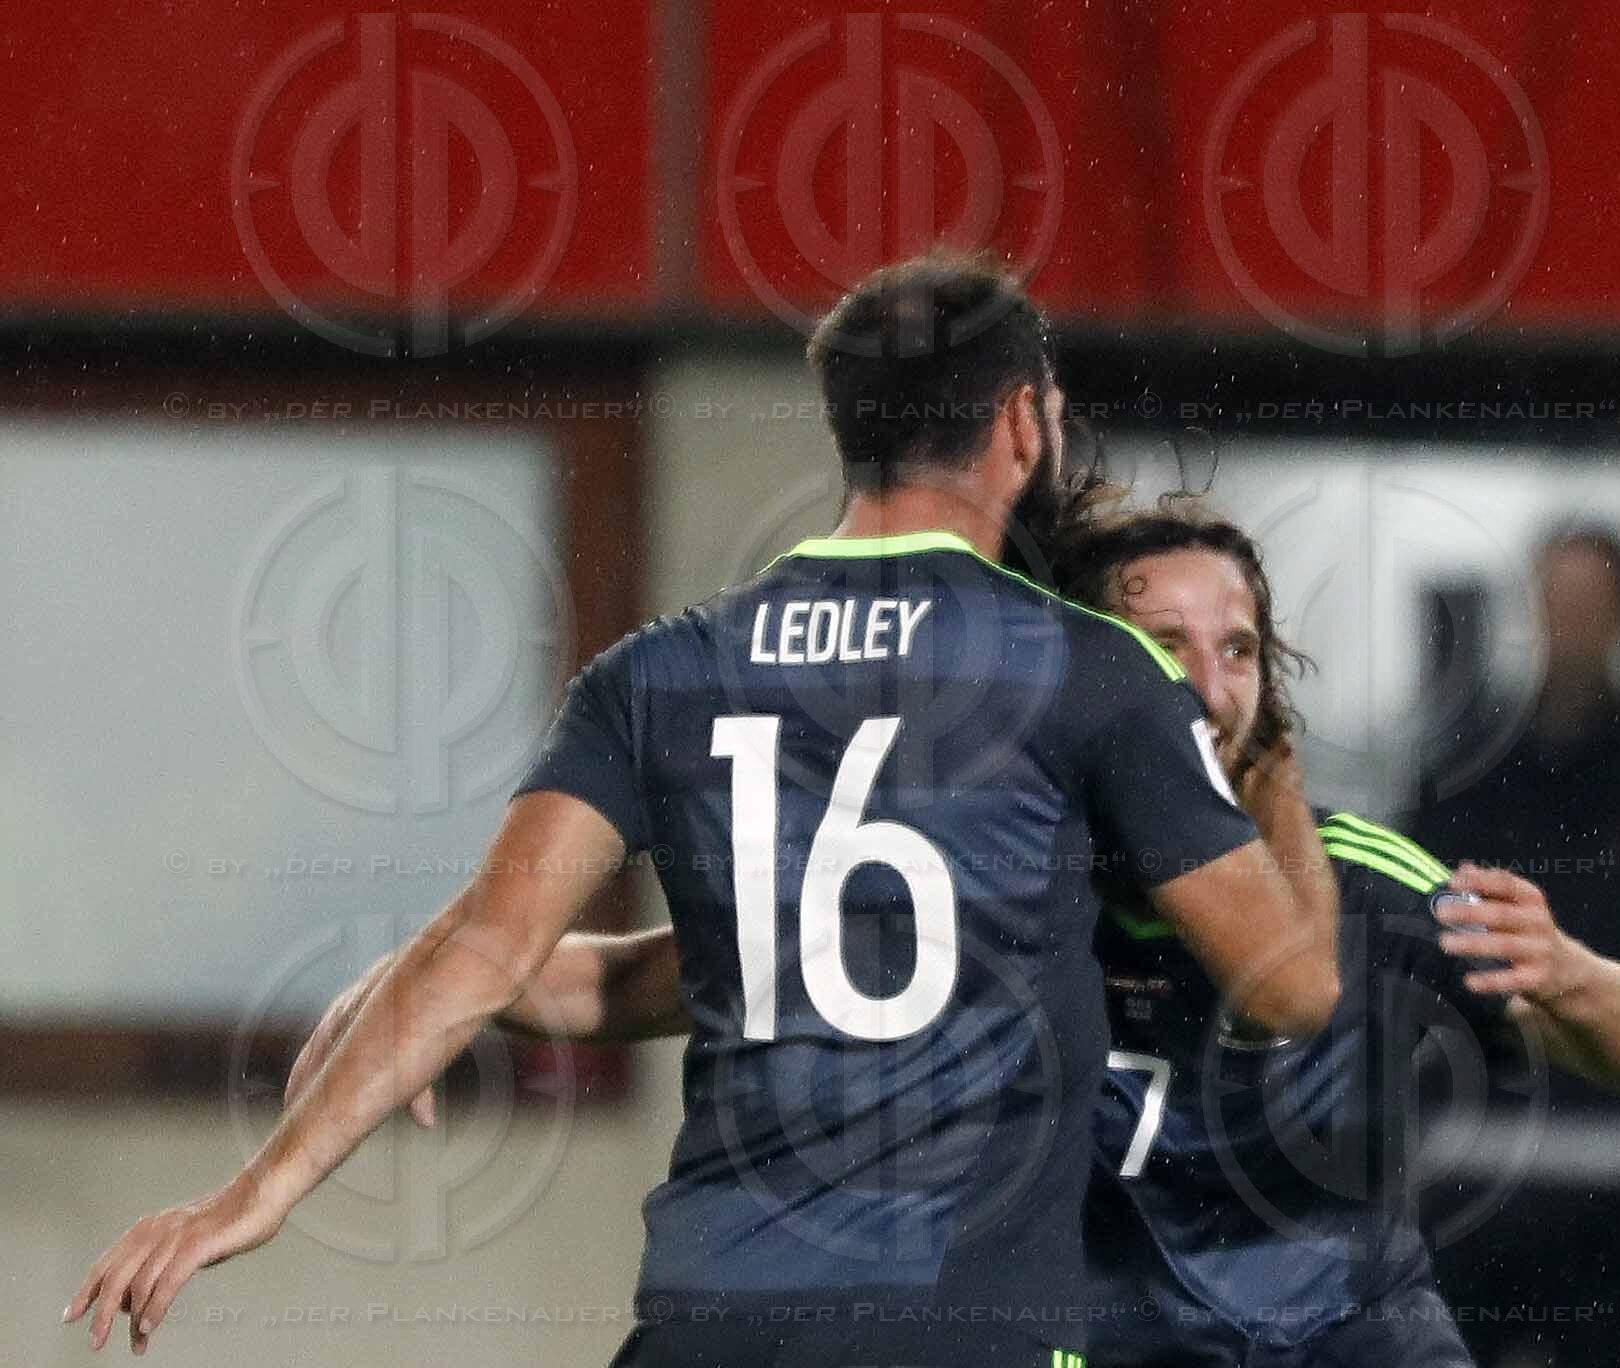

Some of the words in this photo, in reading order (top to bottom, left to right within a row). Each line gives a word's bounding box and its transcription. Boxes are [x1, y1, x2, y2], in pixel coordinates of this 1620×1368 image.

[750, 599, 931, 664] LEDLEY
[710, 715, 959, 1041] 16
[1107, 1050, 1171, 1177] 7
